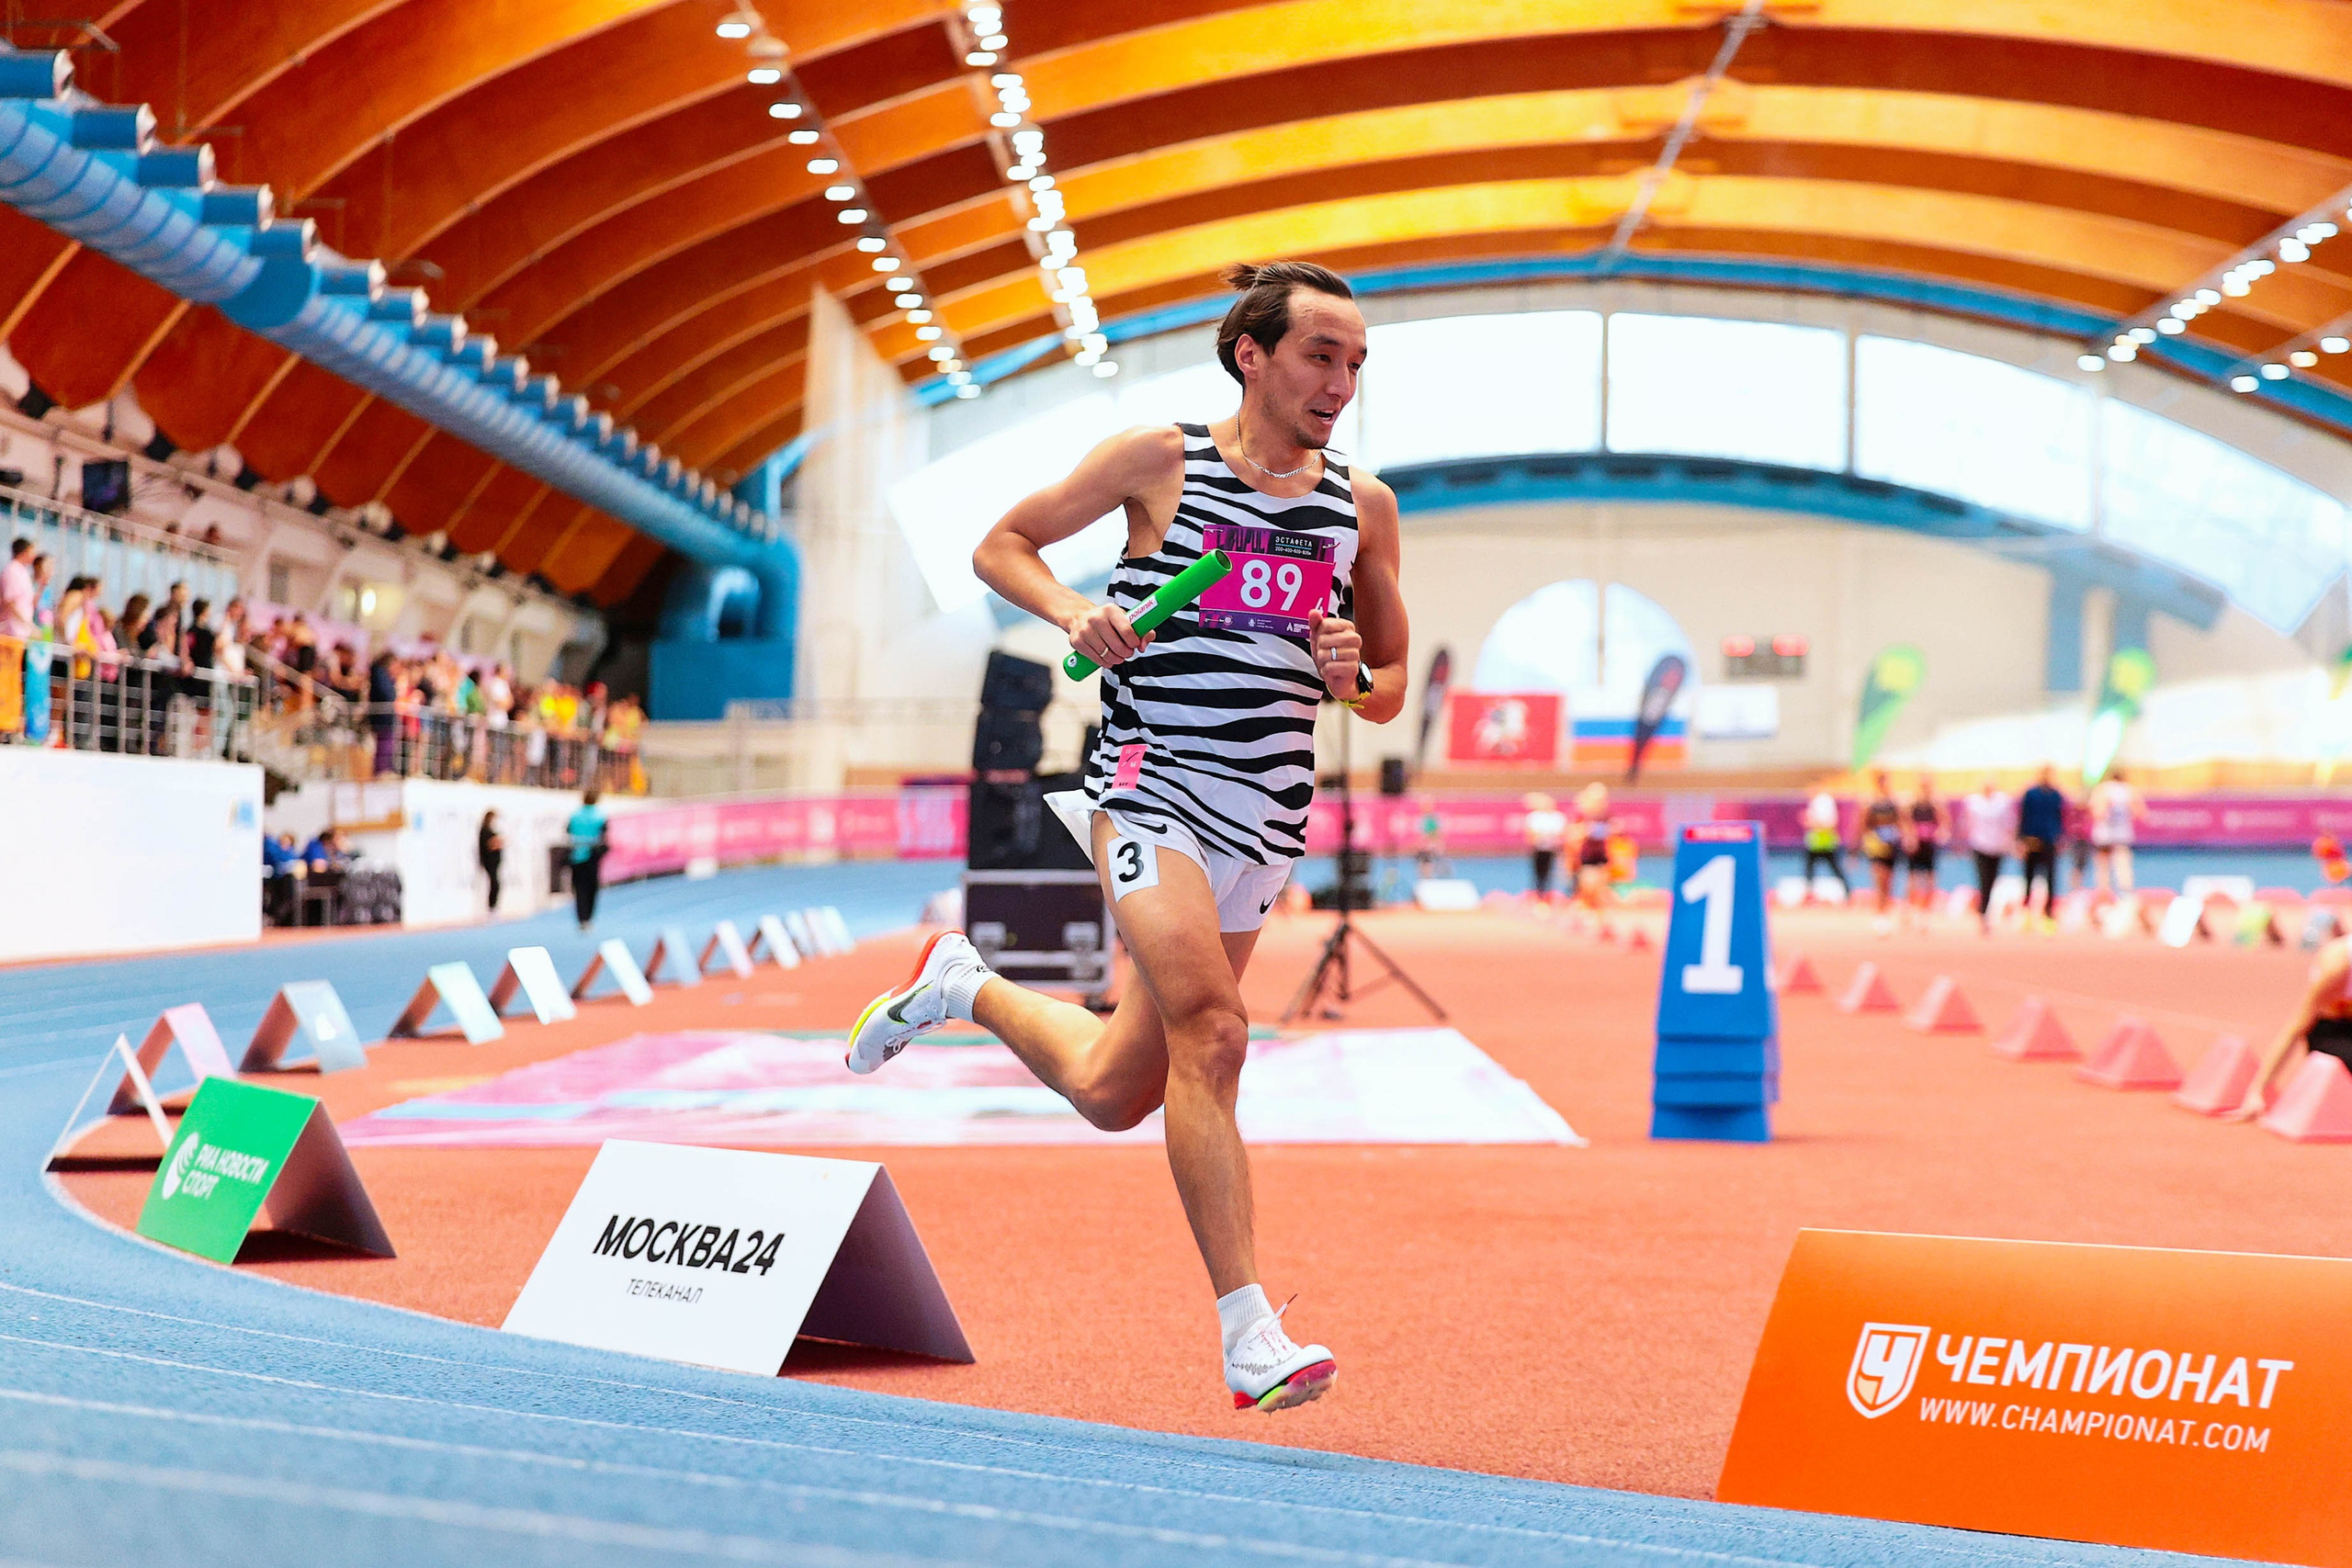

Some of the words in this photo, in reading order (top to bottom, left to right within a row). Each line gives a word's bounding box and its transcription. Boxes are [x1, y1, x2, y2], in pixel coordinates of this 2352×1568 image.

[1275, 536, 1313, 547] ЭСТАФЕТА
[1240, 558, 1303, 612] 89
[1116, 840, 1145, 883] 3
[1680, 853, 1745, 996] 1
[194, 1144, 221, 1170] РИА
[214, 1148, 270, 1185] НОВОСТИ
[593, 1214, 786, 1276] МОСКВА24
[626, 1278, 704, 1304] ТЕЛЕКАНАЛ
[1935, 1333, 2295, 1409] ЧЕМПИОНАТ
[1919, 1396, 2271, 1453] WWW.CHAMPIONAT.COM
